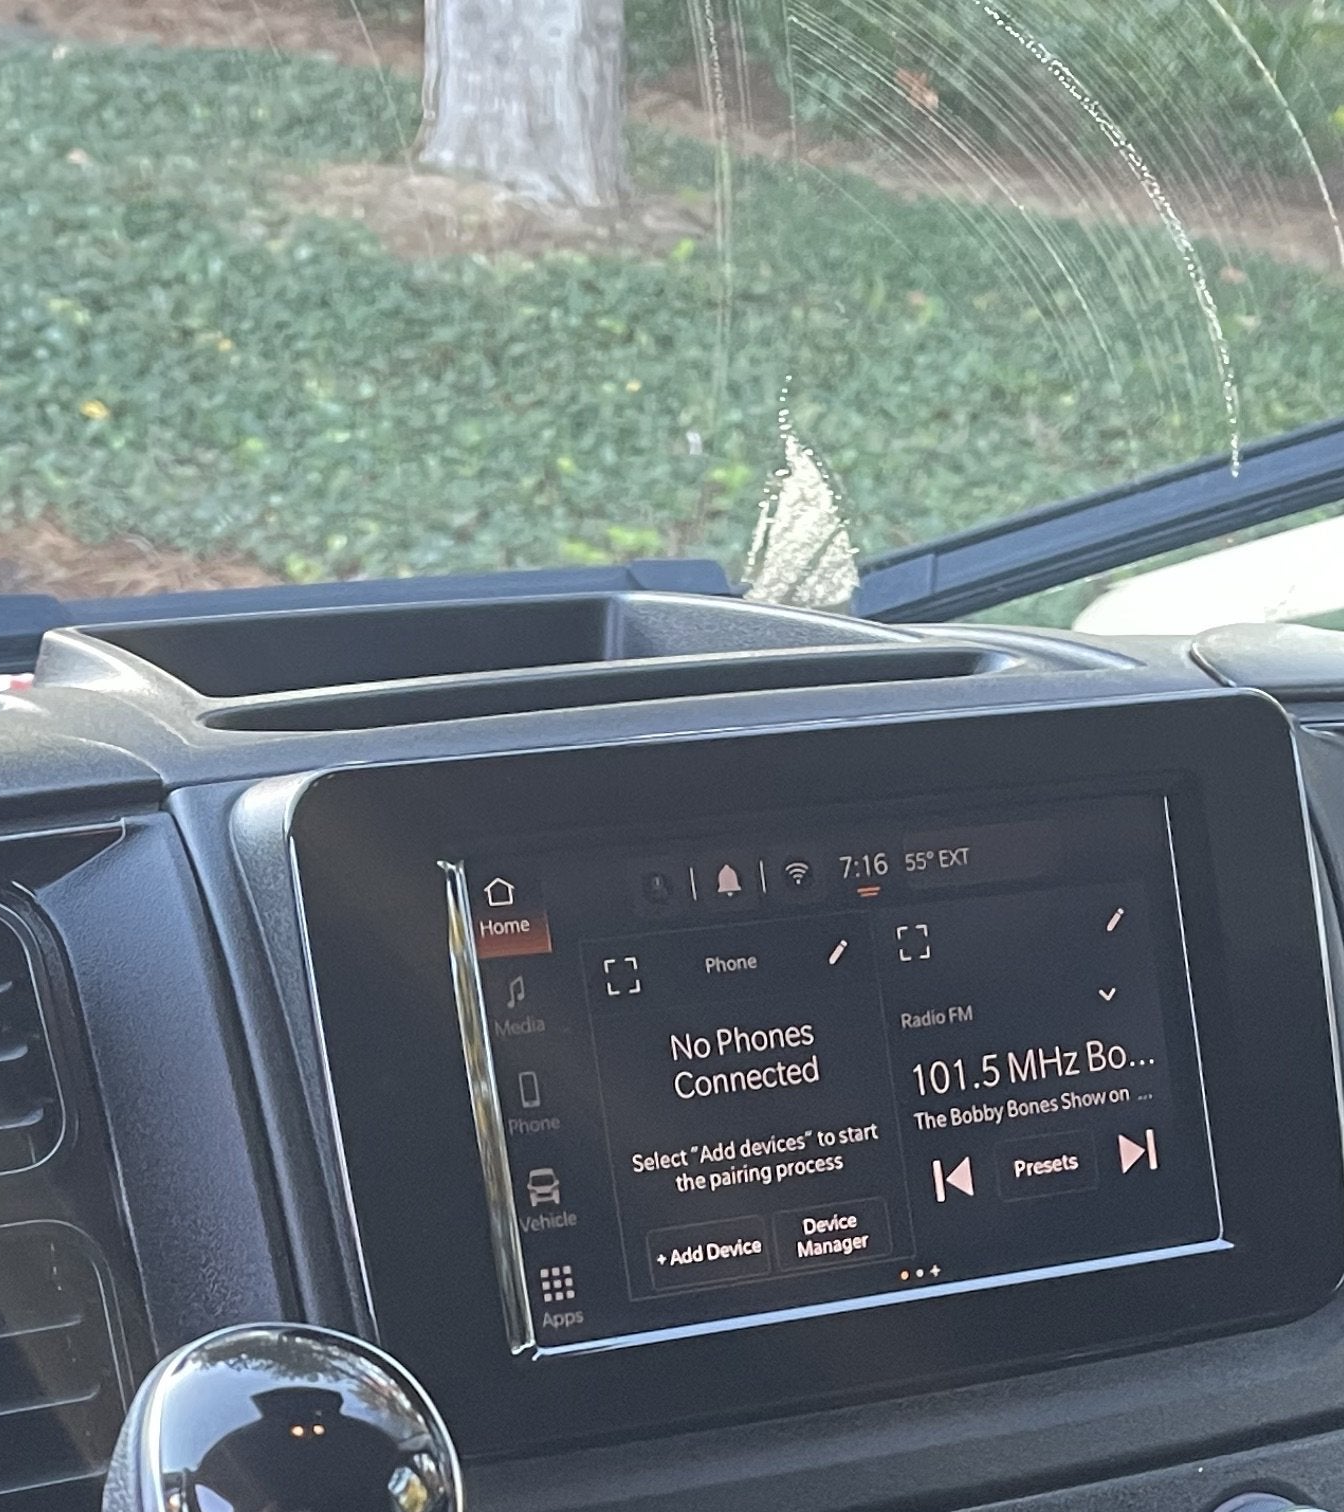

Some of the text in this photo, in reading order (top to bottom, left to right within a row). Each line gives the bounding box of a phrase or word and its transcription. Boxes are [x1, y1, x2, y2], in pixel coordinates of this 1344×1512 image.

[839, 853, 889, 879] 7:16
[939, 847, 971, 869] EXT
[479, 916, 531, 937] Home
[704, 953, 758, 974] Phone
[494, 1015, 546, 1037] Media
[901, 1005, 974, 1029] Radio FM
[670, 1023, 815, 1061] No Phones
[673, 1056, 820, 1099] Connected
[913, 1053, 1002, 1097] 101.5
[1008, 1048, 1081, 1084] MHz
[914, 1109, 948, 1131] The
[951, 1103, 1005, 1128] Bobby
[1007, 1096, 1060, 1119] Bones
[1061, 1090, 1108, 1111] Show
[1109, 1086, 1131, 1102] on
[508, 1115, 561, 1136] Phone
[632, 1151, 689, 1173] Select
[817, 1129, 836, 1147] to
[838, 1122, 880, 1145] start
[676, 1154, 844, 1193] the pairing process
[1014, 1154, 1079, 1178] Presets
[520, 1210, 578, 1233] Vehicle
[803, 1212, 859, 1235] Device
[669, 1245, 703, 1267] Add
[706, 1238, 763, 1263] Device
[797, 1232, 870, 1258] Manager
[542, 1309, 585, 1331] Apps
